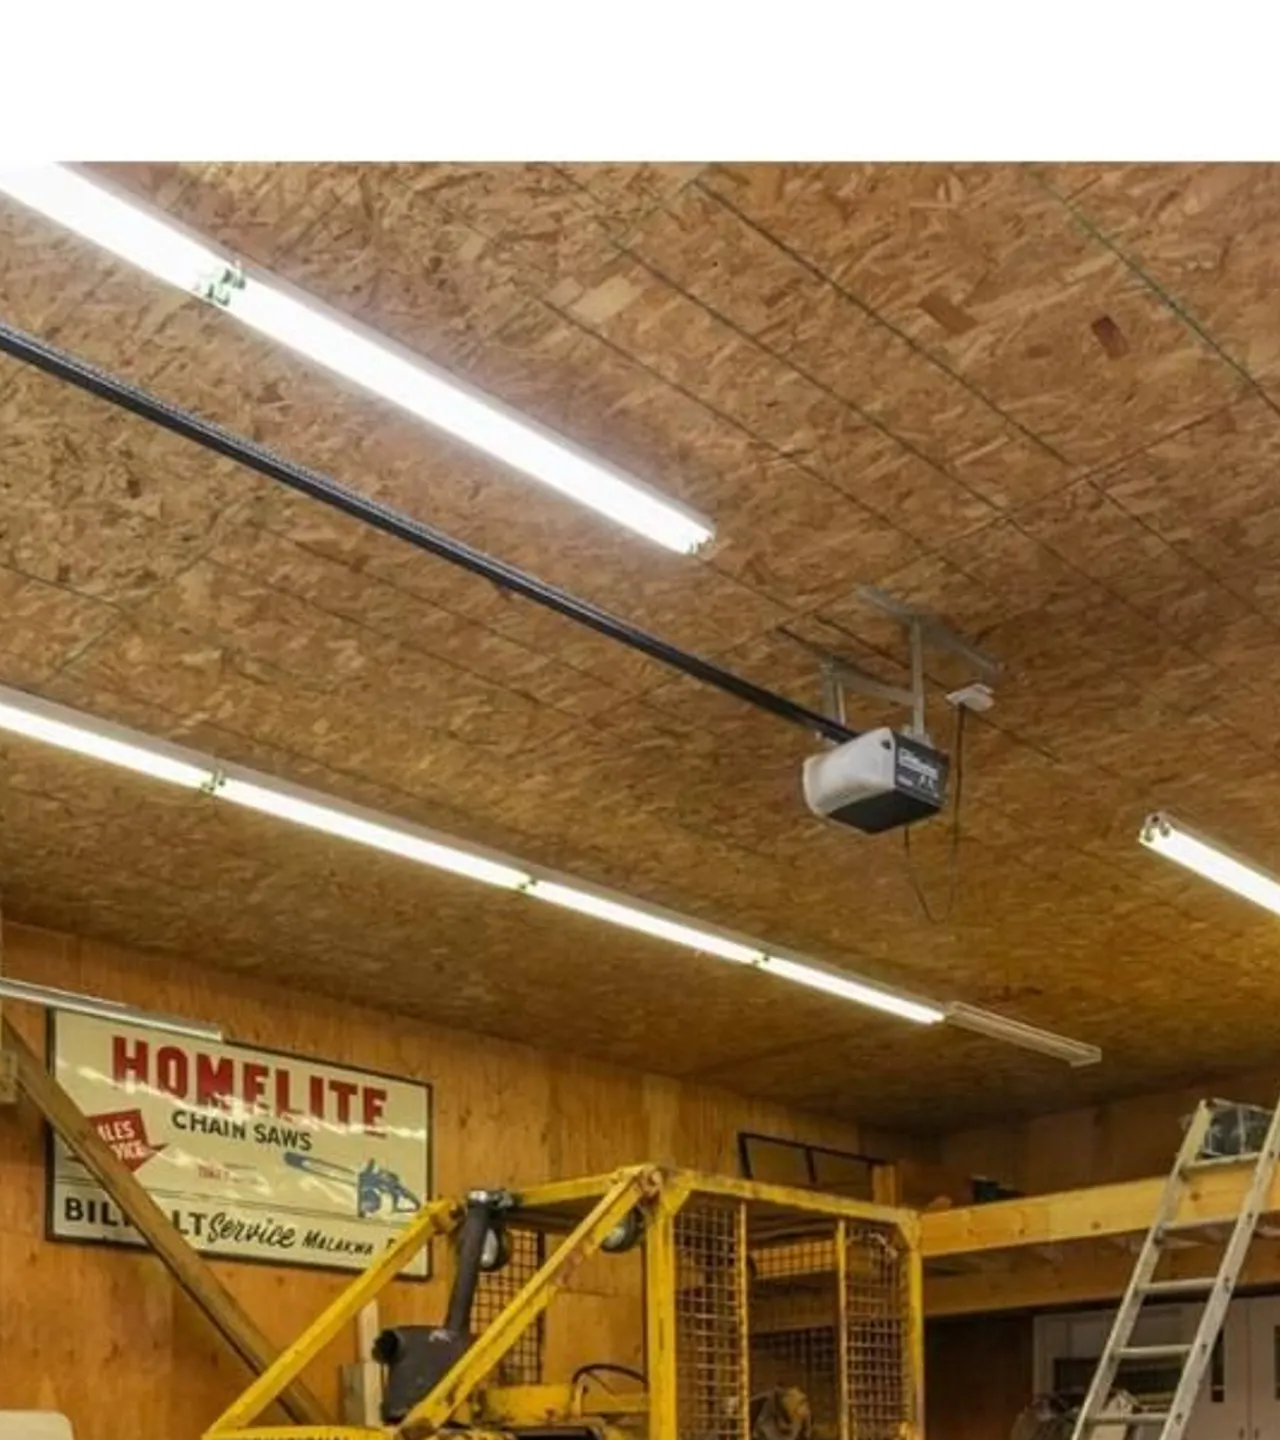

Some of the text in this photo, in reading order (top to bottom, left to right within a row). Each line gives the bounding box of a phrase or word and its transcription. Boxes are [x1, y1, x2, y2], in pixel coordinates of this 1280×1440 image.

[111, 1035, 388, 1138] HOMELITE
[171, 1108, 313, 1152] CHAIN SAWS
[206, 1212, 296, 1248] Service
